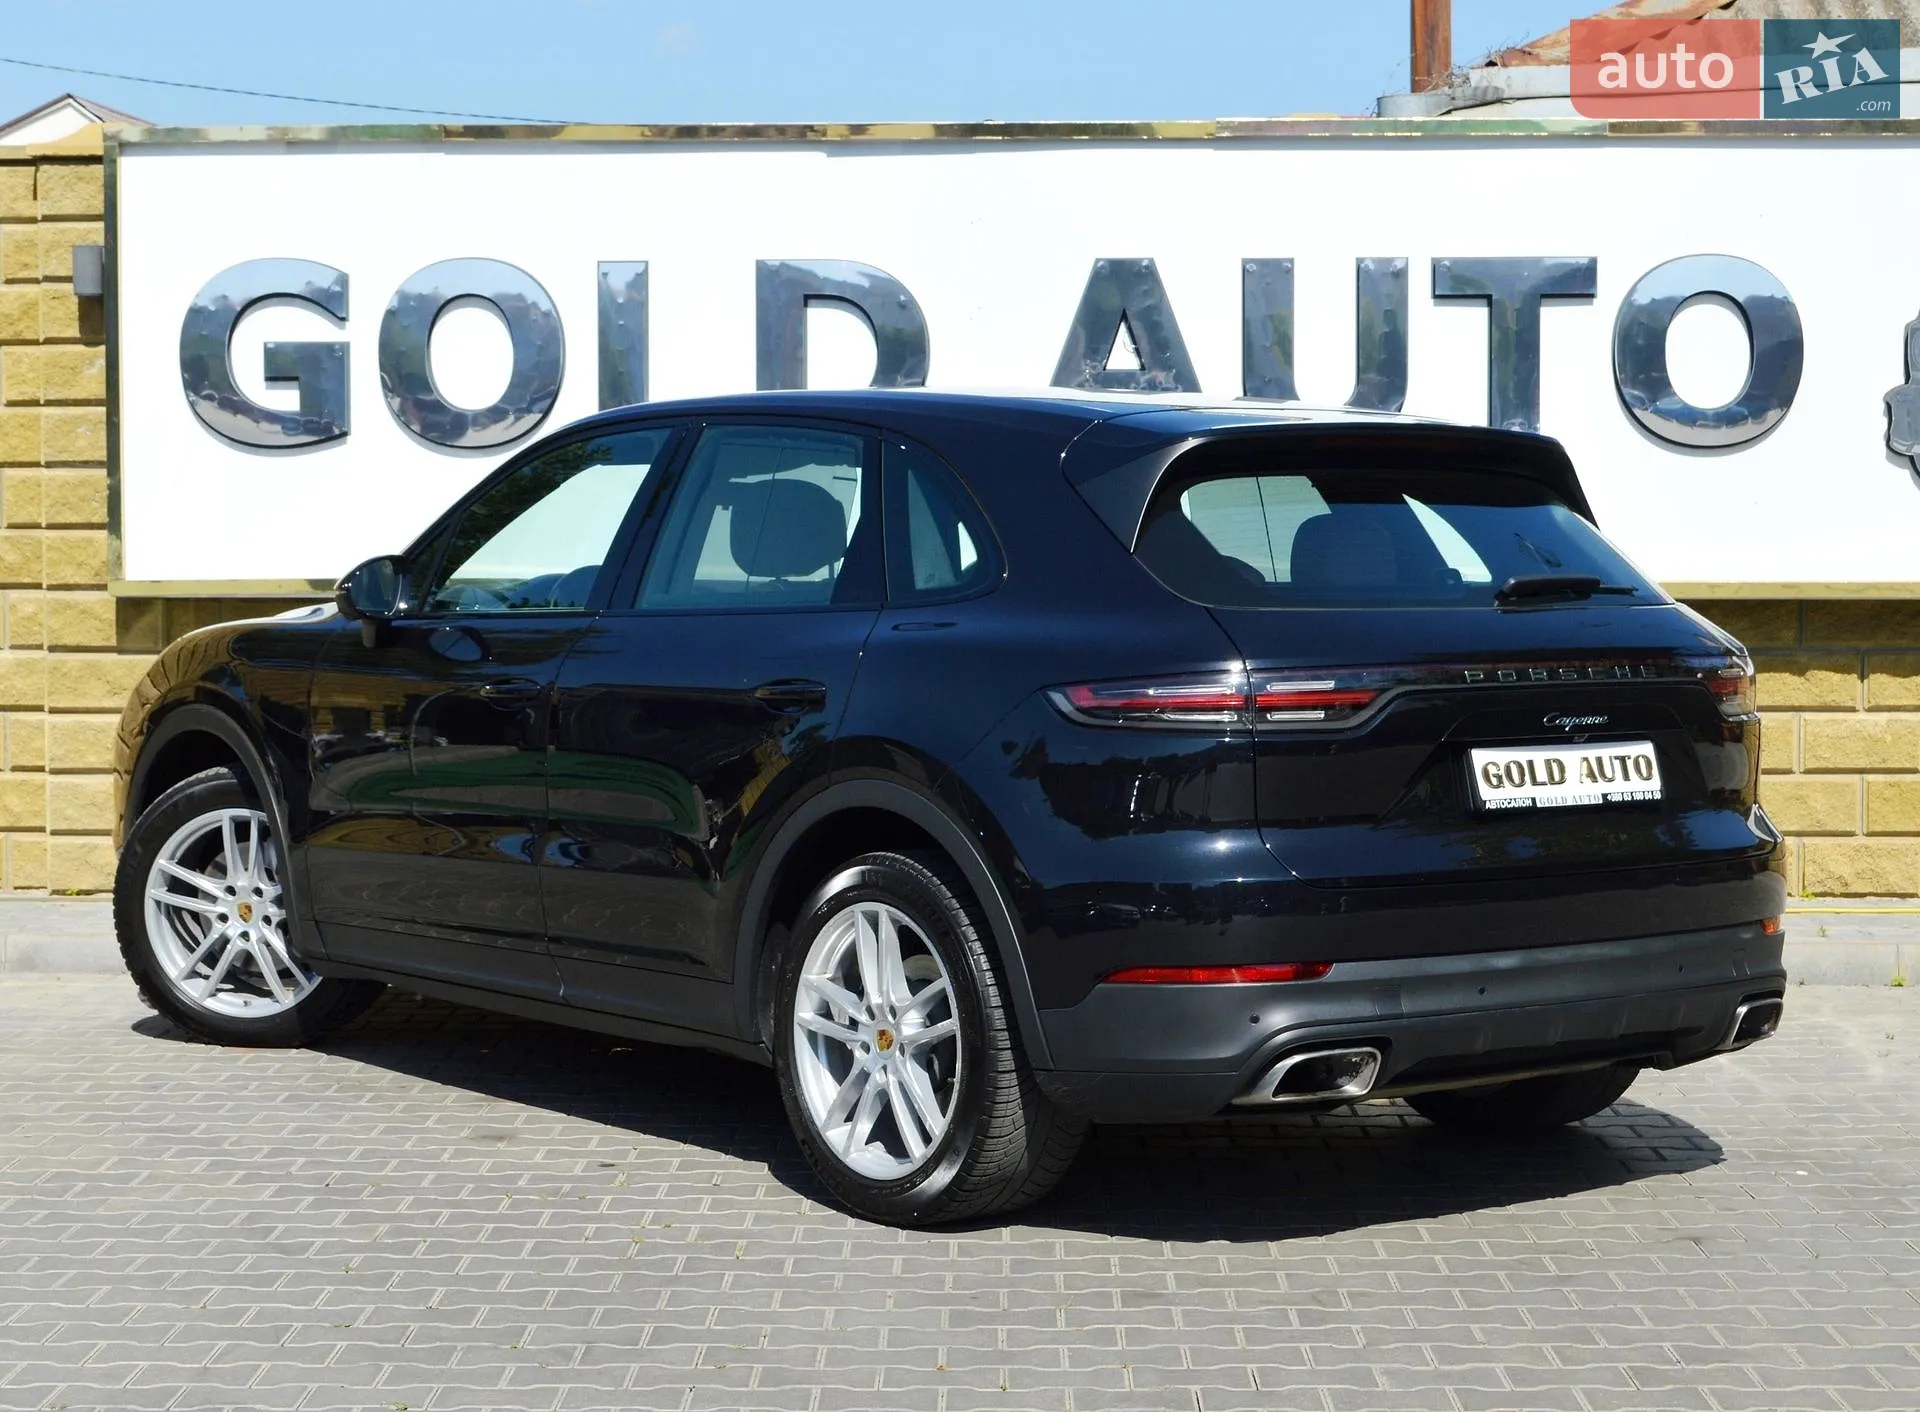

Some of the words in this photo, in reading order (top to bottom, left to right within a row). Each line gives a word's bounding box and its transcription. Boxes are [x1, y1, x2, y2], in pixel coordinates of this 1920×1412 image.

[180, 257, 931, 450] GOLD
[1050, 253, 1805, 448] AUTO
[1464, 665, 1657, 684] PORSCHE
[1543, 712, 1609, 731] Cayenne
[1481, 757, 1567, 789] GOLD
[1579, 754, 1653, 784] AUTO
[1485, 798, 1533, 809] АВТОСАЛОН
[1538, 795, 1568, 806] GOLD
[1571, 793, 1601, 805] AUTO
